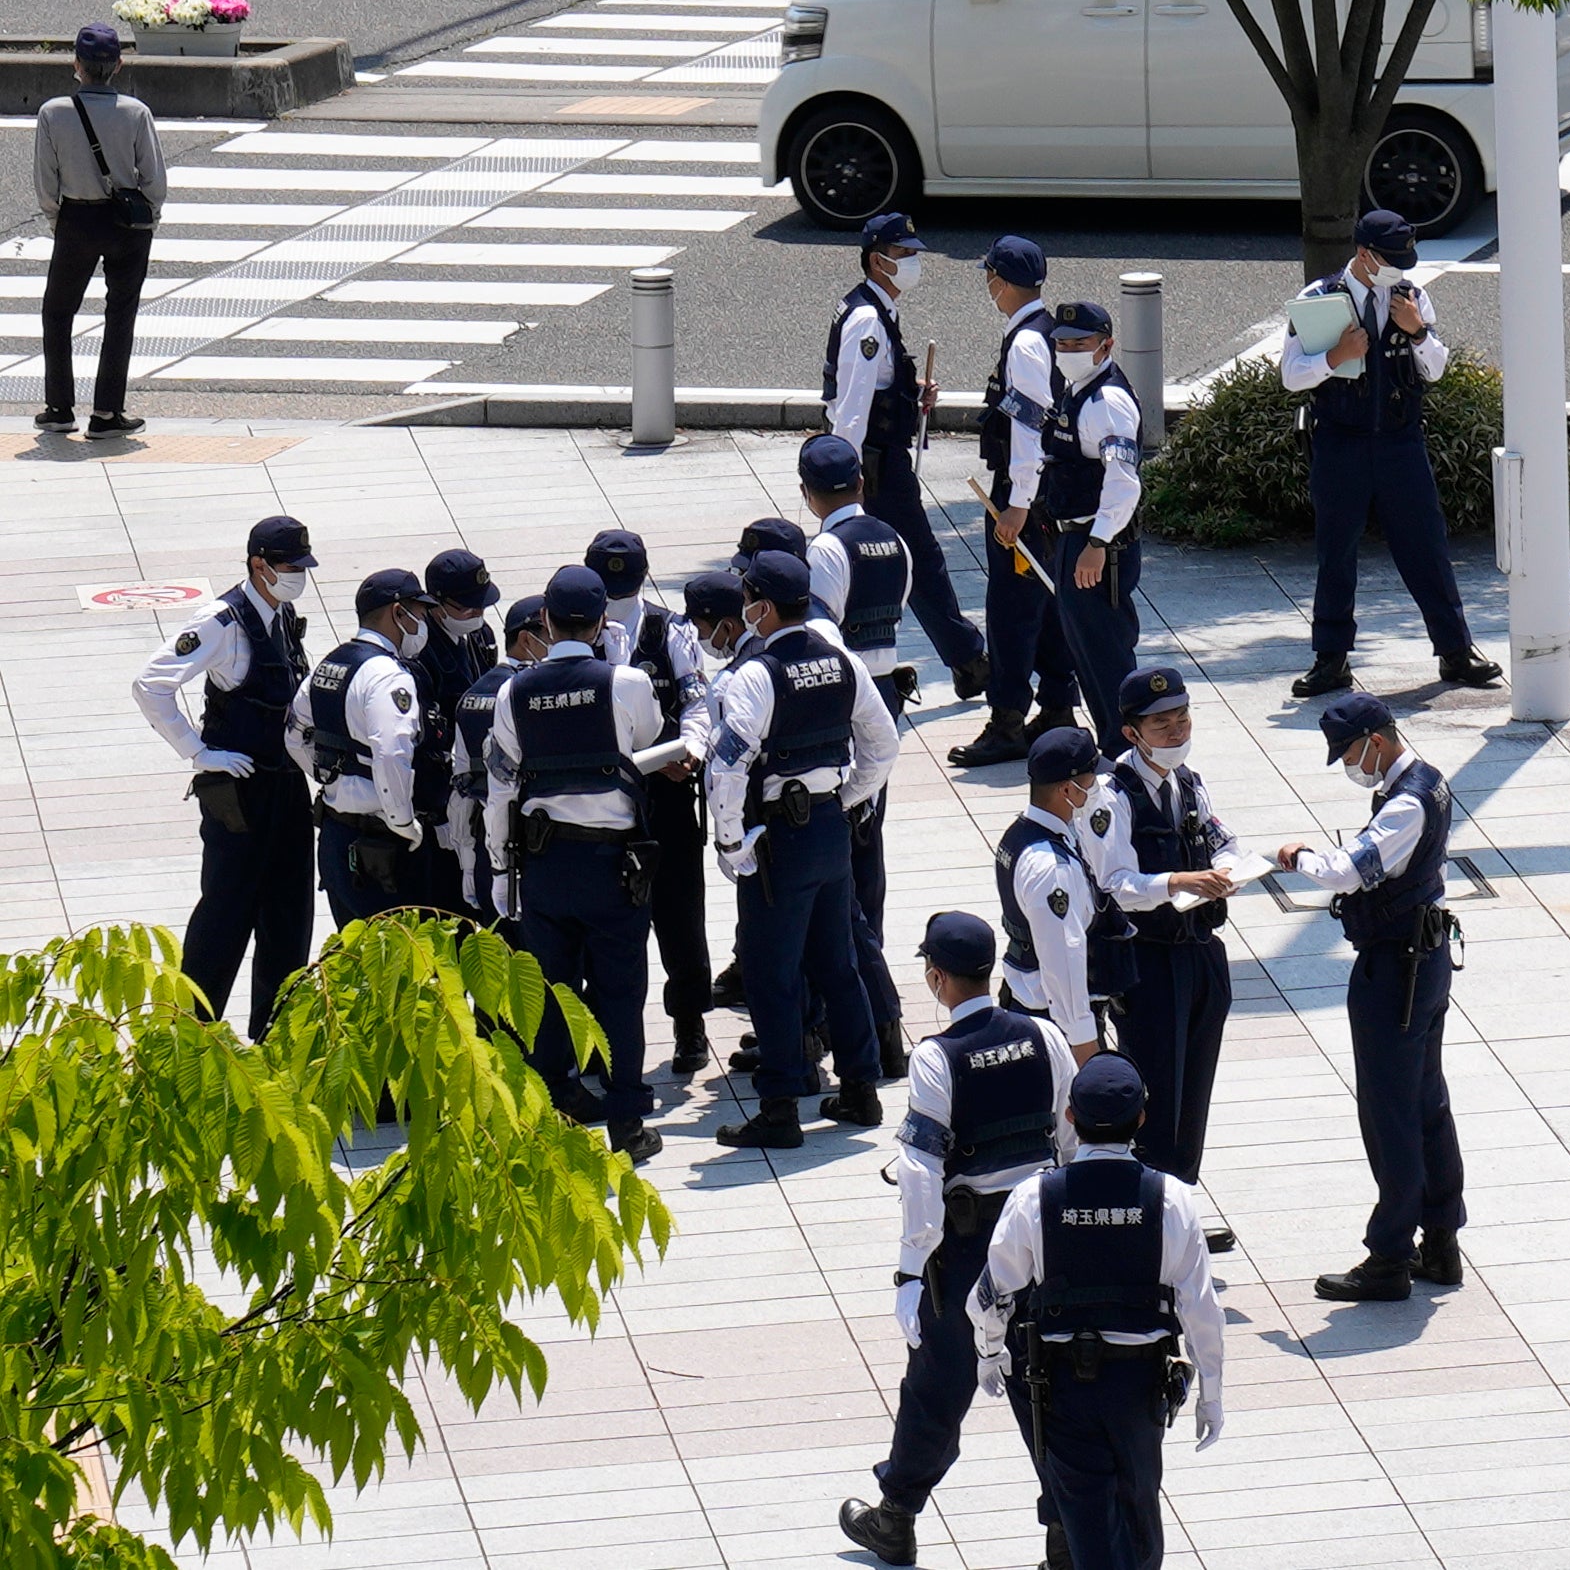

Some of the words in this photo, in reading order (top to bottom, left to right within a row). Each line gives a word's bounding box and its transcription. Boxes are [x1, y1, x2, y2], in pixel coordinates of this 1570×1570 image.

[795, 672, 841, 690] POLICE
[529, 689, 595, 710] 埼玉県警察
[970, 1041, 1035, 1069] 埼玉県警察
[1062, 1208, 1143, 1226] 埼玉県警察
